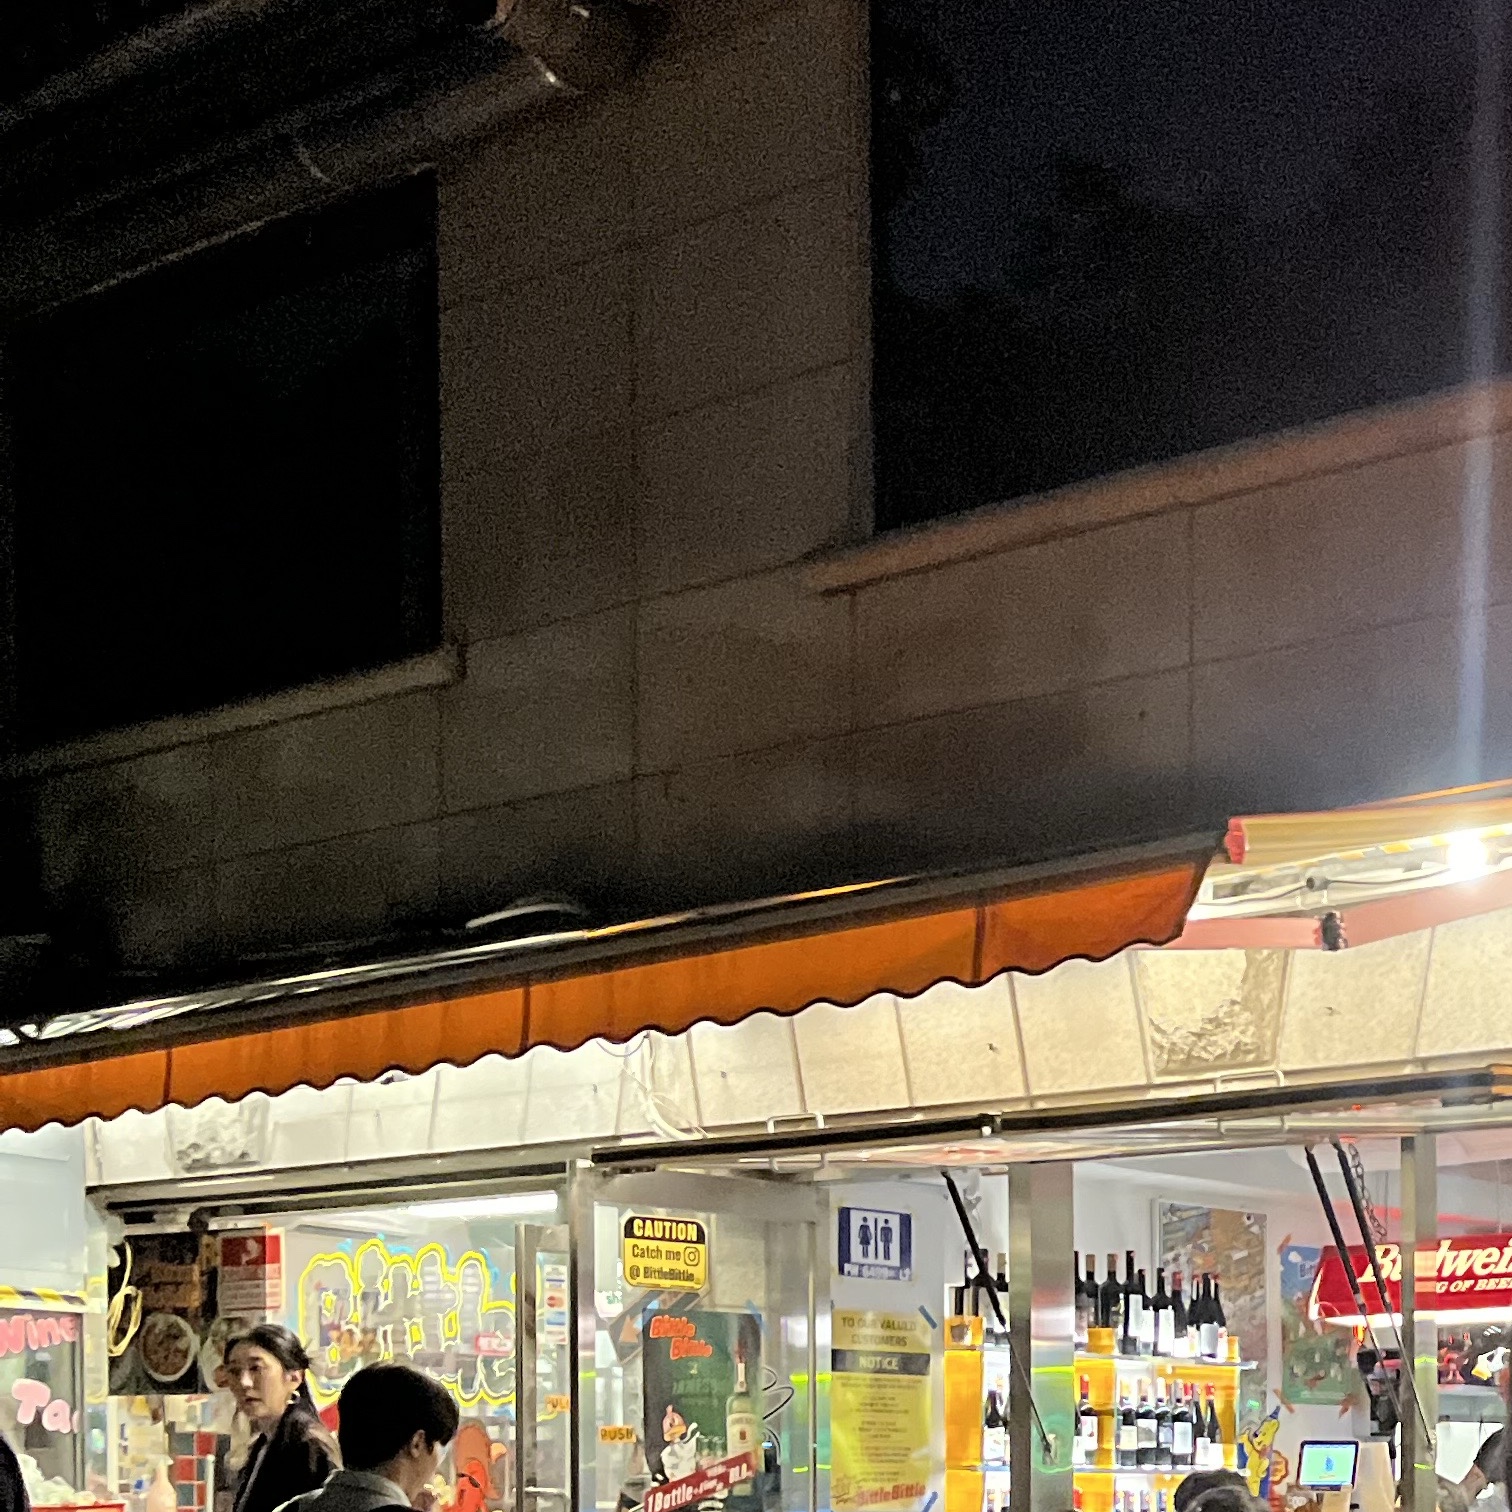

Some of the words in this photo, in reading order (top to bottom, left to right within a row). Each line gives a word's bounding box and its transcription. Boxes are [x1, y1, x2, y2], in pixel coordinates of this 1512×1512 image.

[633, 1218, 698, 1242] CAUTION
[632, 1244, 662, 1260] Catch
[665, 1250, 681, 1261] me
[1449, 1279, 1475, 1293] OF
[842, 1317, 855, 1328] TO
[859, 1356, 900, 1371] NOTICE
[600, 1427, 634, 1441] PUSH
